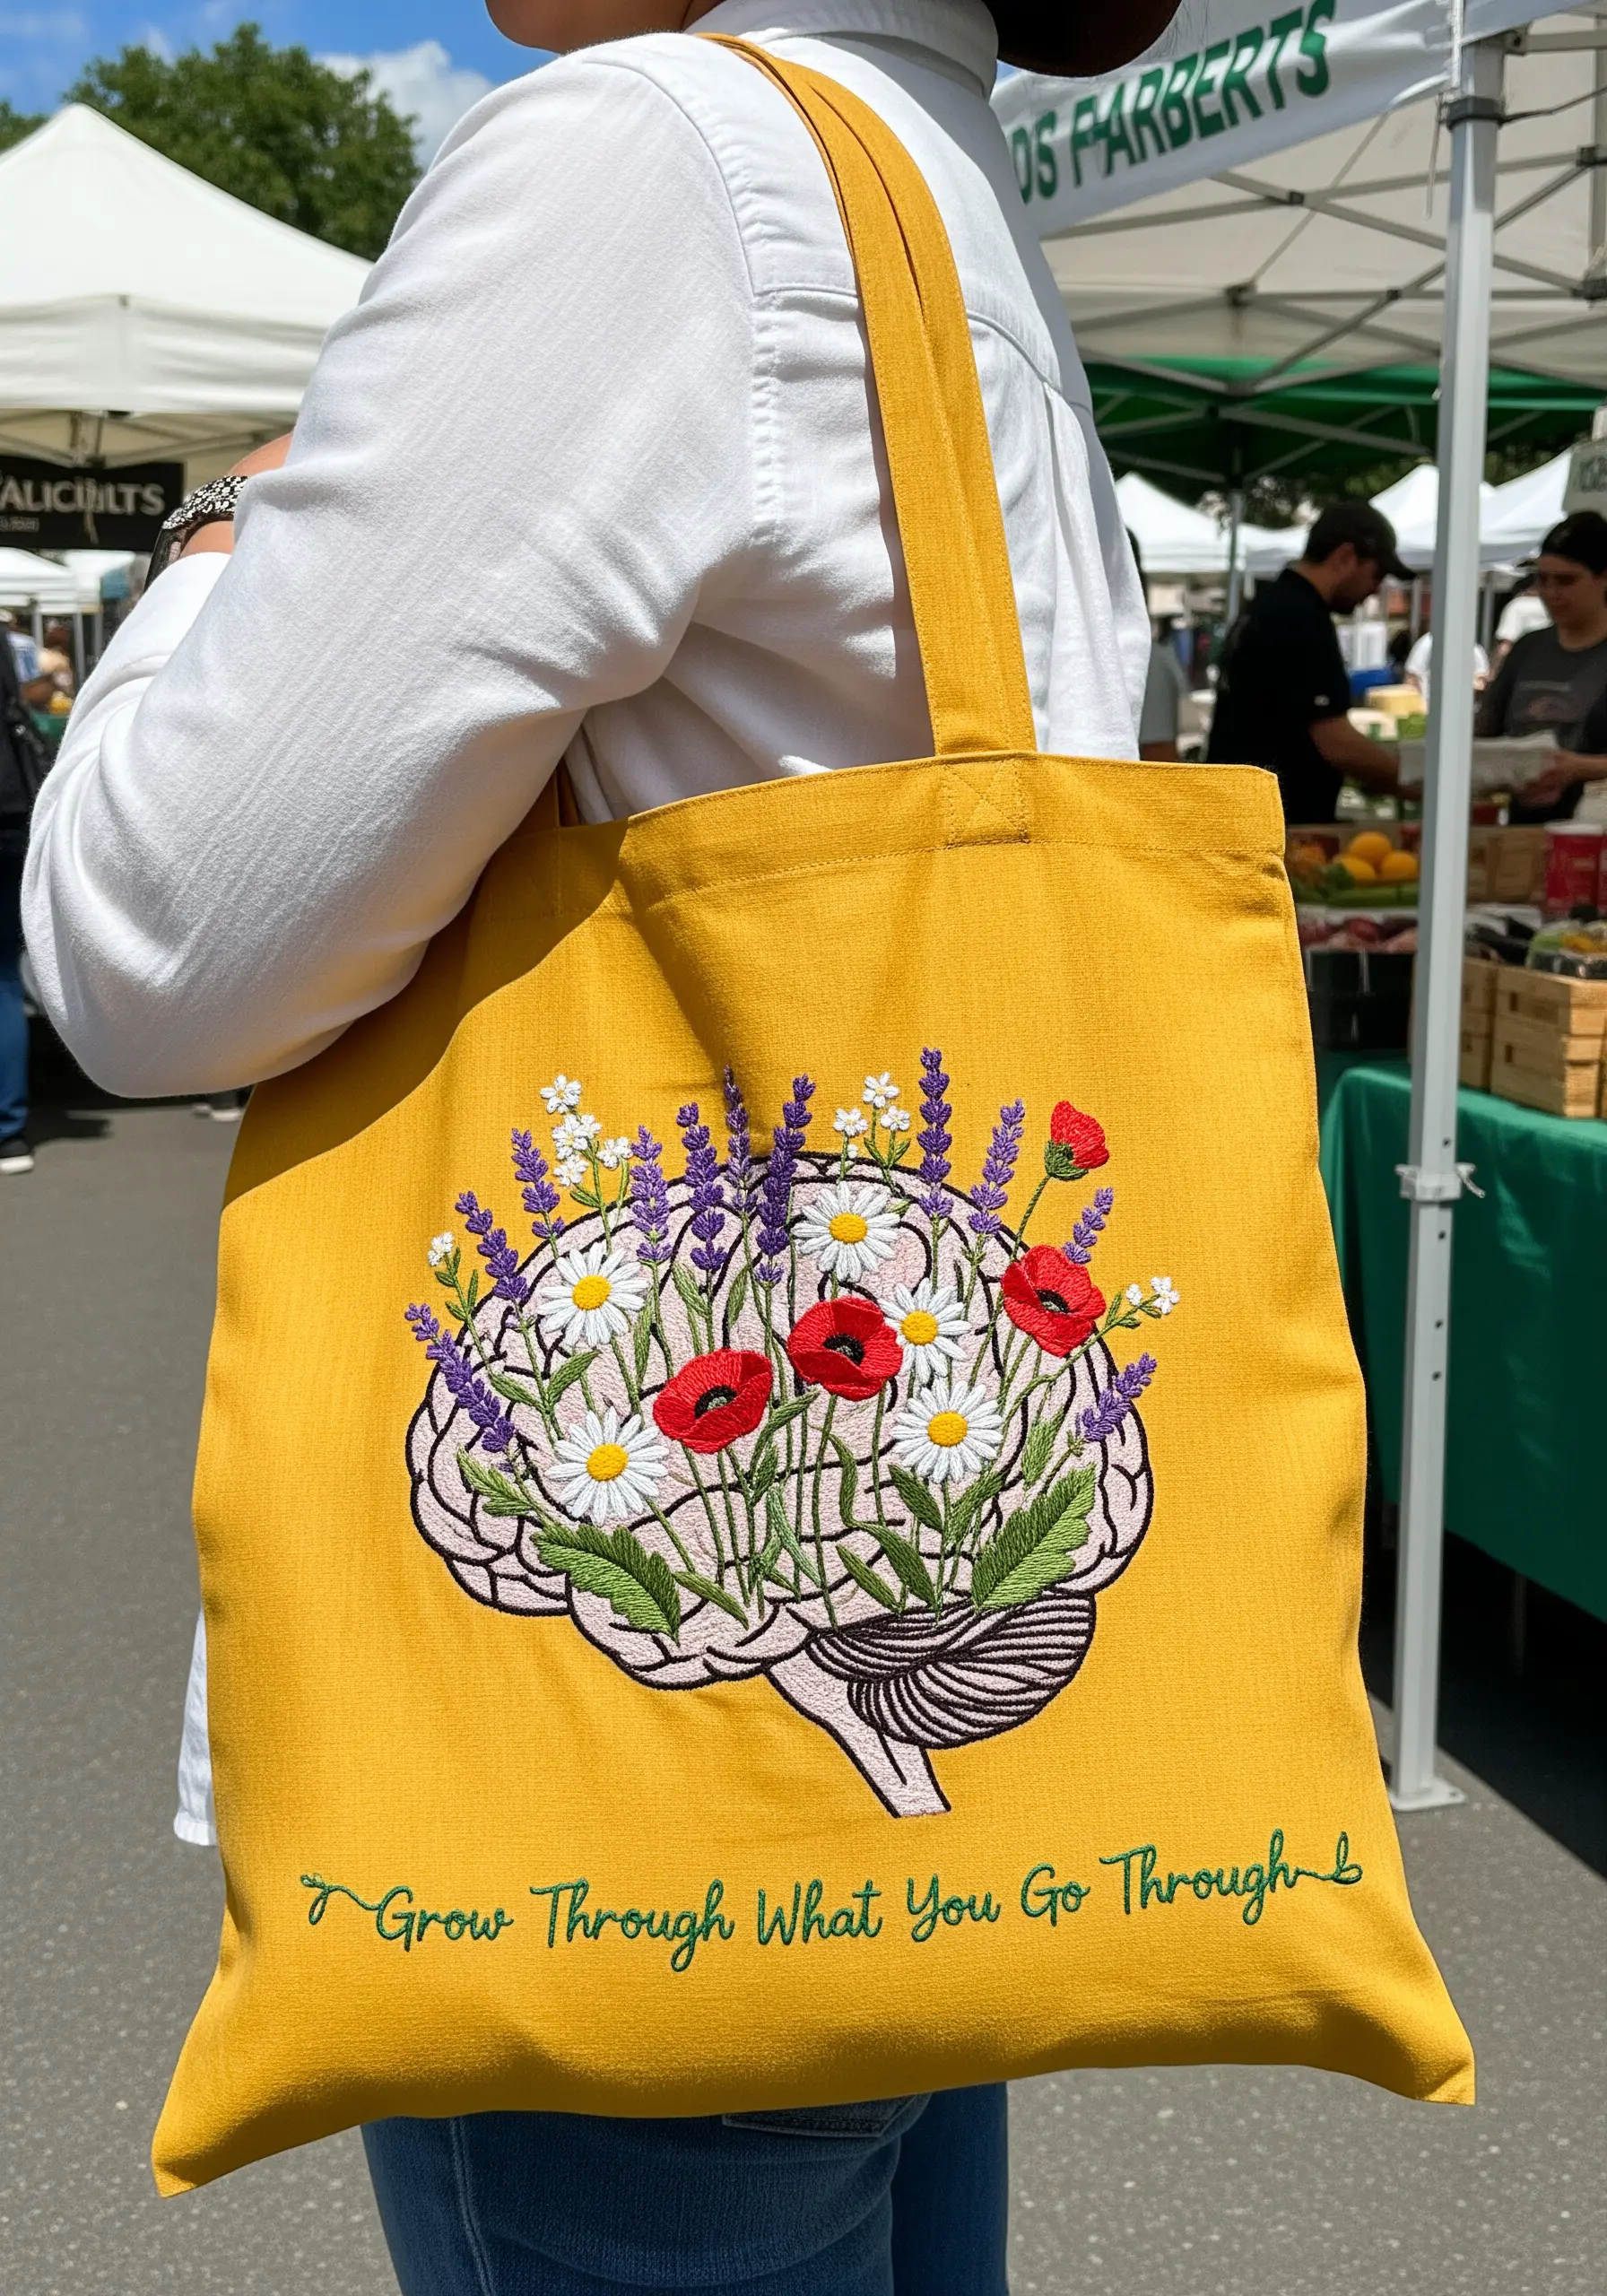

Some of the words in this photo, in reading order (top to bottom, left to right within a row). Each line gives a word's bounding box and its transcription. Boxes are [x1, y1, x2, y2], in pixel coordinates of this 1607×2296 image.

[375, 1884, 515, 1952] Grow
[529, 1876, 735, 1972] Through
[757, 1877, 883, 1946] What
[907, 1873, 1002, 1943] You
[1020, 1862, 1090, 1926] Go
[1099, 1828, 1305, 1926] Through
